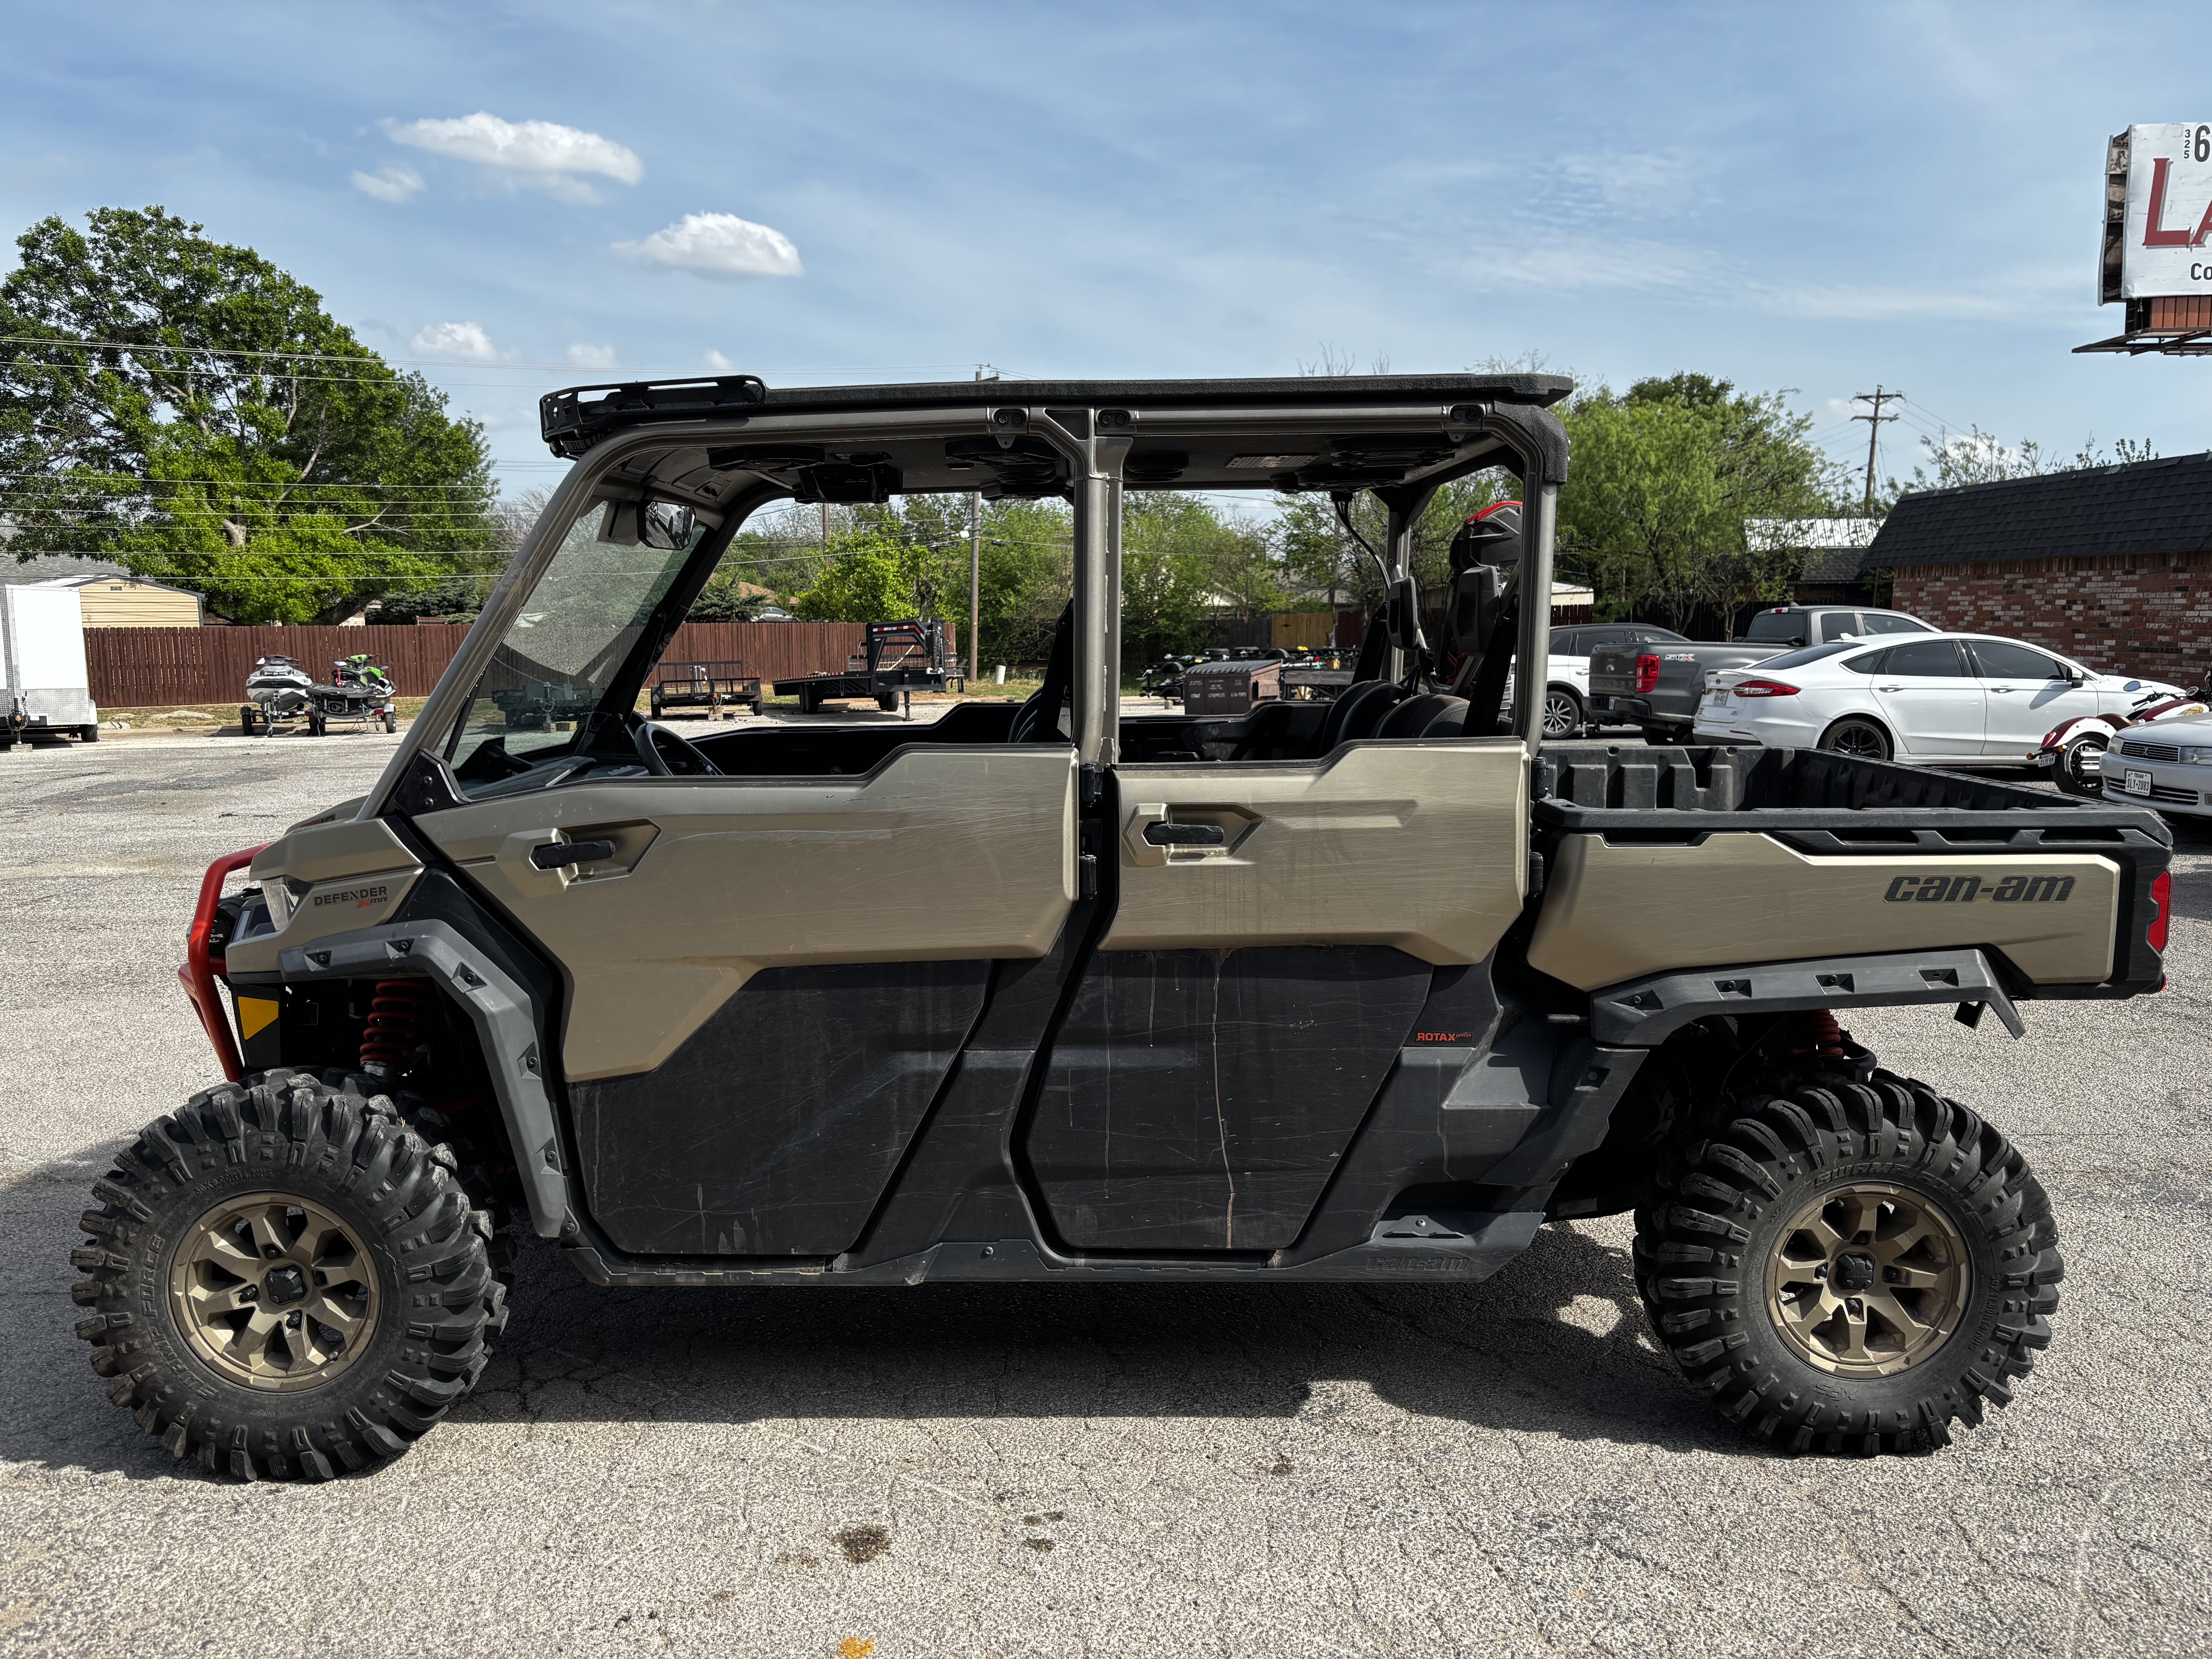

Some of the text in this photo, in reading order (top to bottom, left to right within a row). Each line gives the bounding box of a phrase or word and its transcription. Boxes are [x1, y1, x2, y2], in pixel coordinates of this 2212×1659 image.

[314, 886, 387, 906] DEFENDER
[1884, 876, 2075, 902] can-am
[1417, 1032, 1456, 1041] ROTAX
[1366, 1257, 1469, 1271] can-am
[140, 1234, 165, 1317] FORCE
